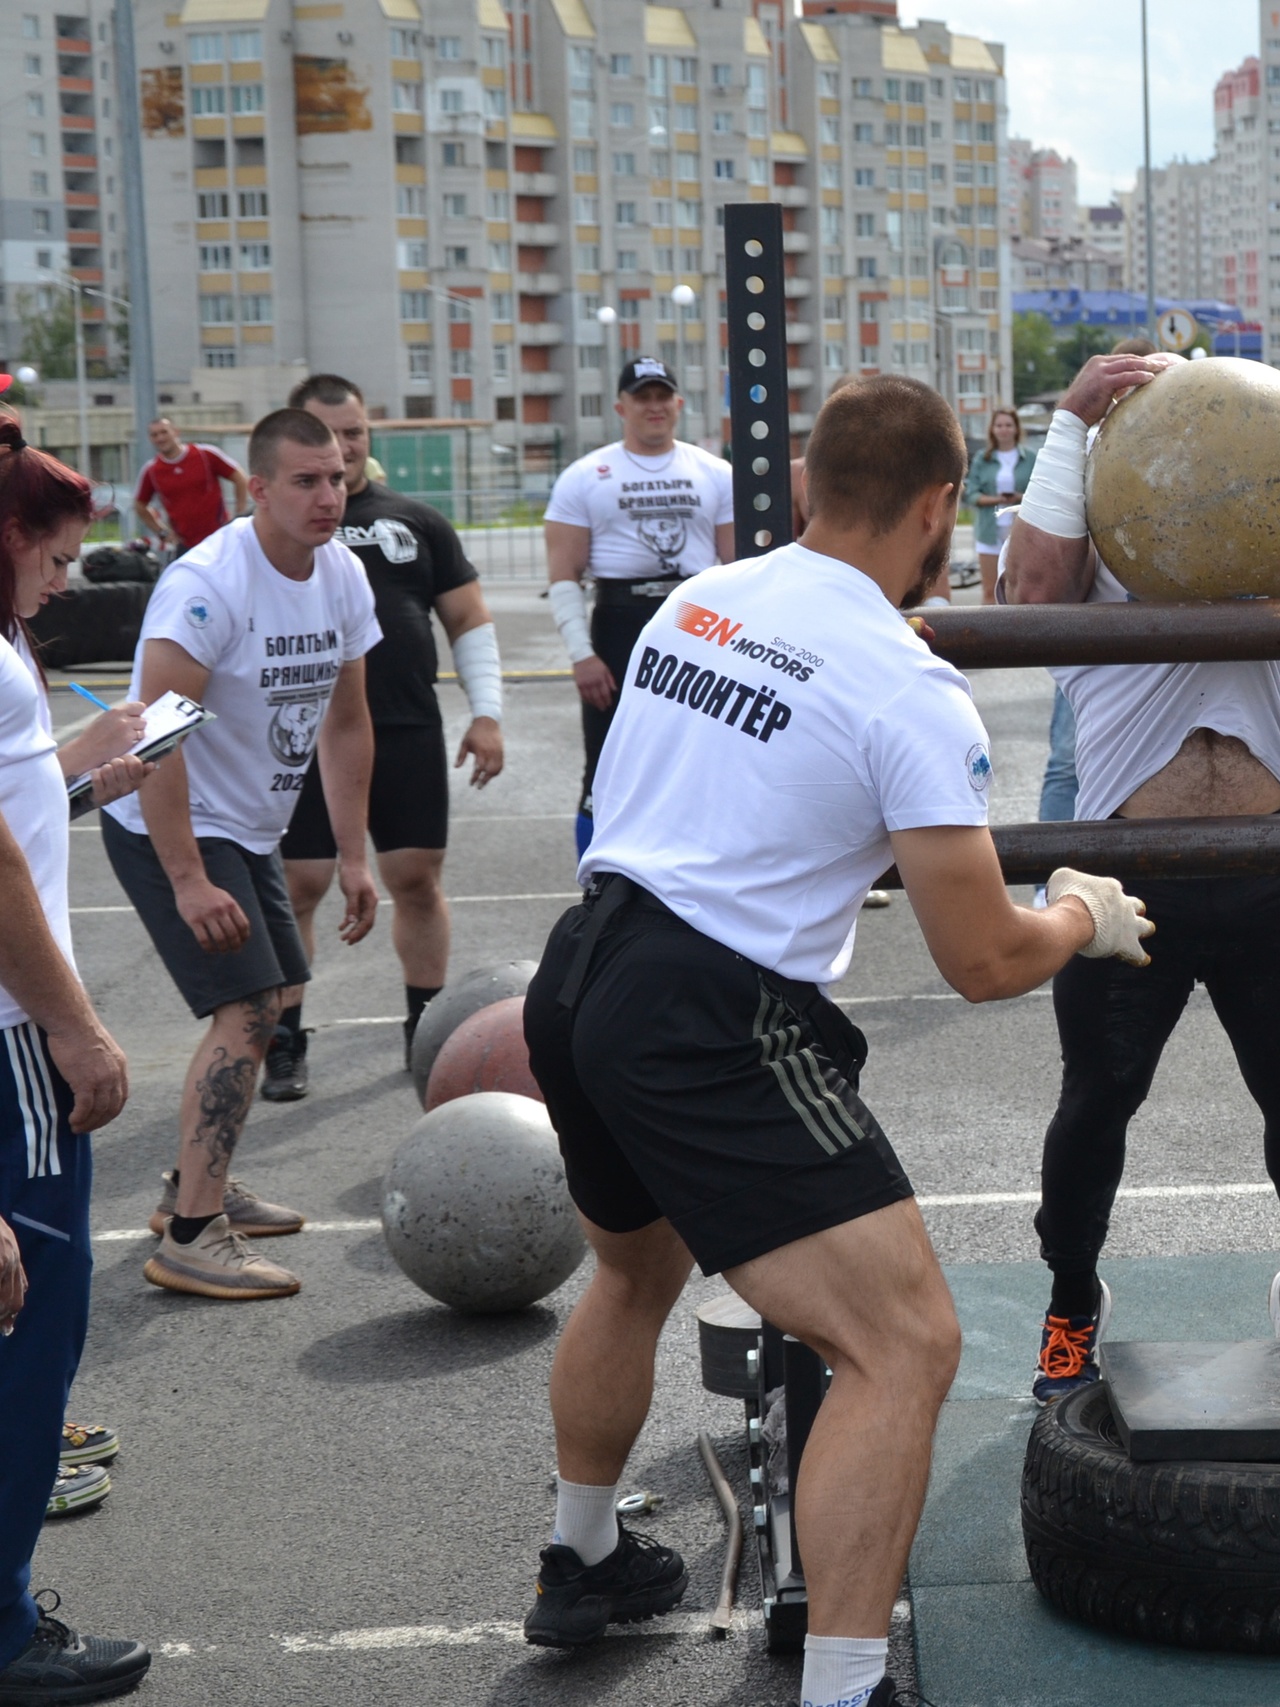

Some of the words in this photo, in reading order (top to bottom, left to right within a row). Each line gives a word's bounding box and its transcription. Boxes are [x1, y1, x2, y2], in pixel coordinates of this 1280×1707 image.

[622, 480, 693, 492] БОГАТЫРИ
[619, 495, 701, 509] БРЯНЩИНЫ
[674, 600, 744, 648] BN
[770, 637, 796, 654] Since
[795, 648, 825, 668] 2000
[634, 646, 792, 743] ВОЛОНТЁР
[269, 773, 305, 792] 202
